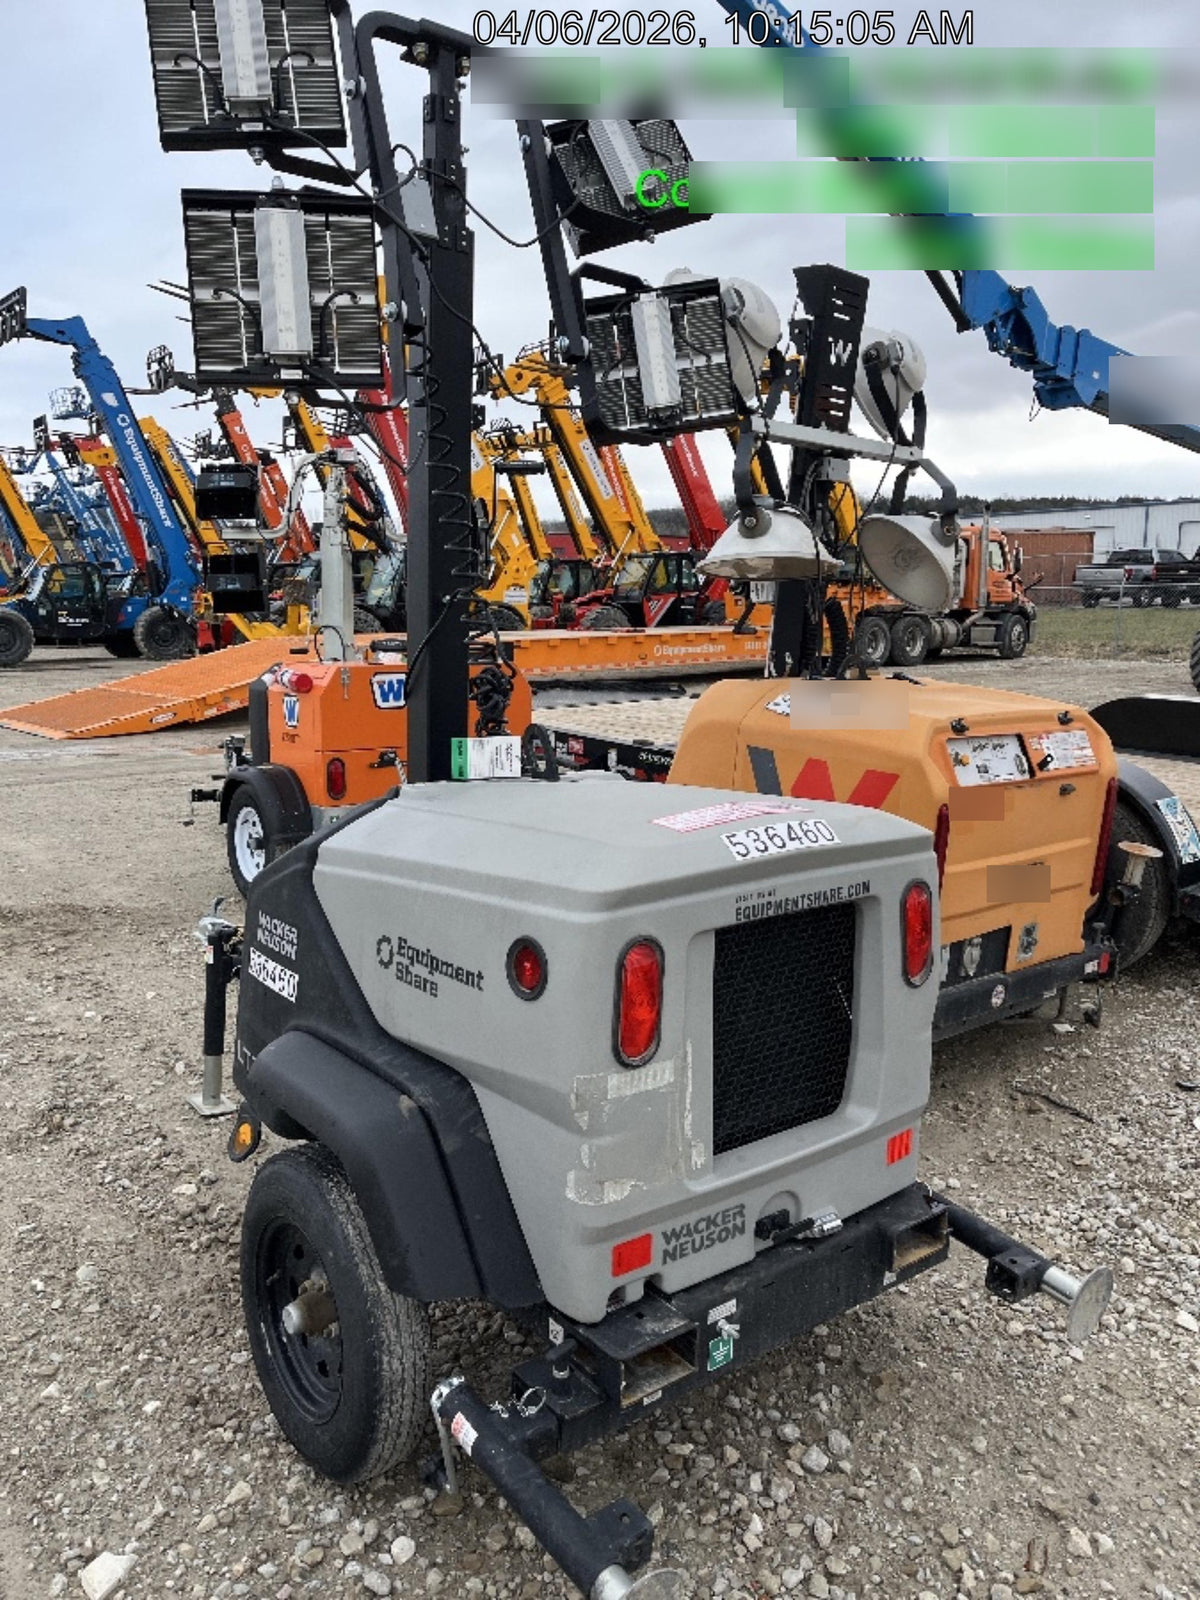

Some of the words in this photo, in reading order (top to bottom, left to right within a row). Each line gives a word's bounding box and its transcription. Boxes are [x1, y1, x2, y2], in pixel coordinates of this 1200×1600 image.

[725, 819, 835, 858] 536460
[256, 927, 298, 961] NEUSON
[258, 909, 298, 945] WACKER
[395, 960, 438, 998] Share
[396, 936, 485, 992] Equipment
[661, 1203, 746, 1246] WACKER
[661, 1220, 746, 1266] NEUSON
